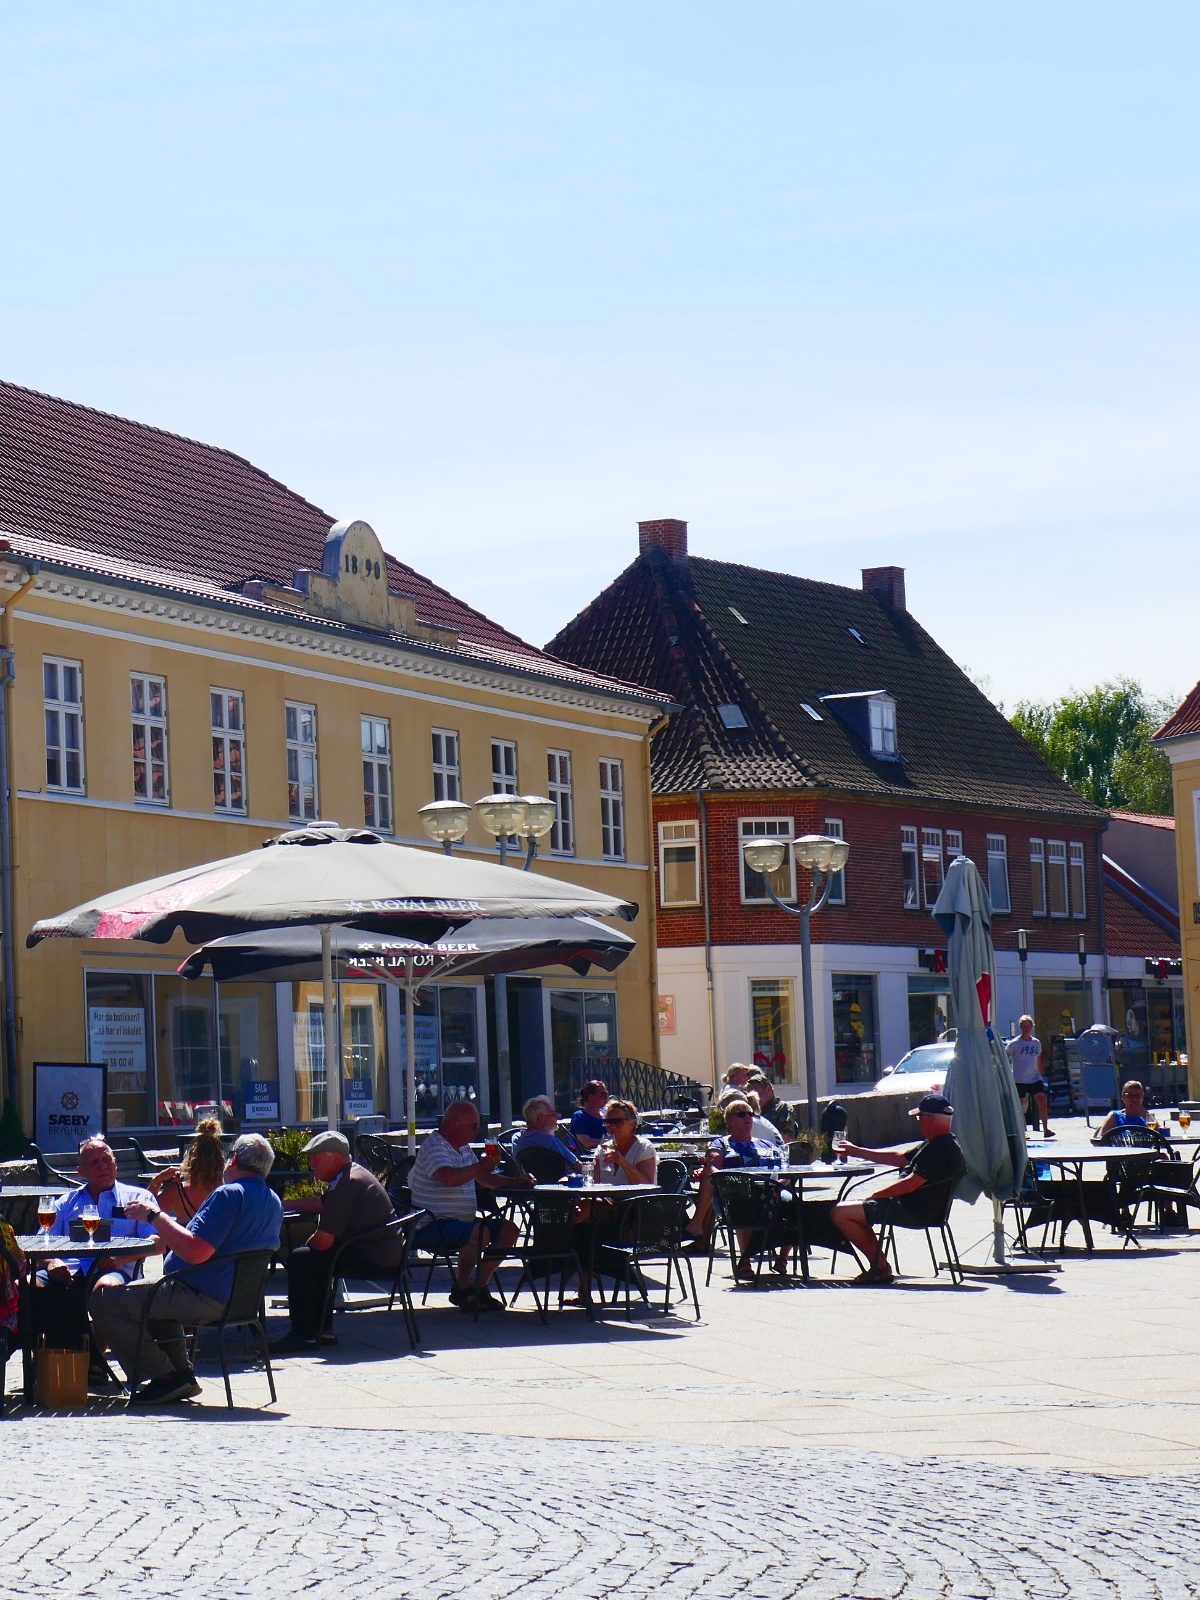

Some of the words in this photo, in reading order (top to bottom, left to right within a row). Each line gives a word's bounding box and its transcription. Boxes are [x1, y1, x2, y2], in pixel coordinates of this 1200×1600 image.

[370, 899, 434, 911] ROYAL
[436, 900, 487, 911] BEER
[380, 943, 434, 951] ROYAL
[436, 943, 480, 951] BEER
[94, 1012, 104, 1021] Har
[105, 1012, 113, 1021] du
[113, 1012, 140, 1022] butikken?
[105, 1026, 115, 1035] har
[122, 1026, 142, 1036] lokalet
[110, 1058, 117, 1067] 36
[118, 1058, 127, 1067] 00
[127, 1058, 134, 1067] 41
[254, 1083, 268, 1093] SALG
[48, 1114, 91, 1126] SÆBY
[48, 1126, 88, 1136] BRYGHUS
